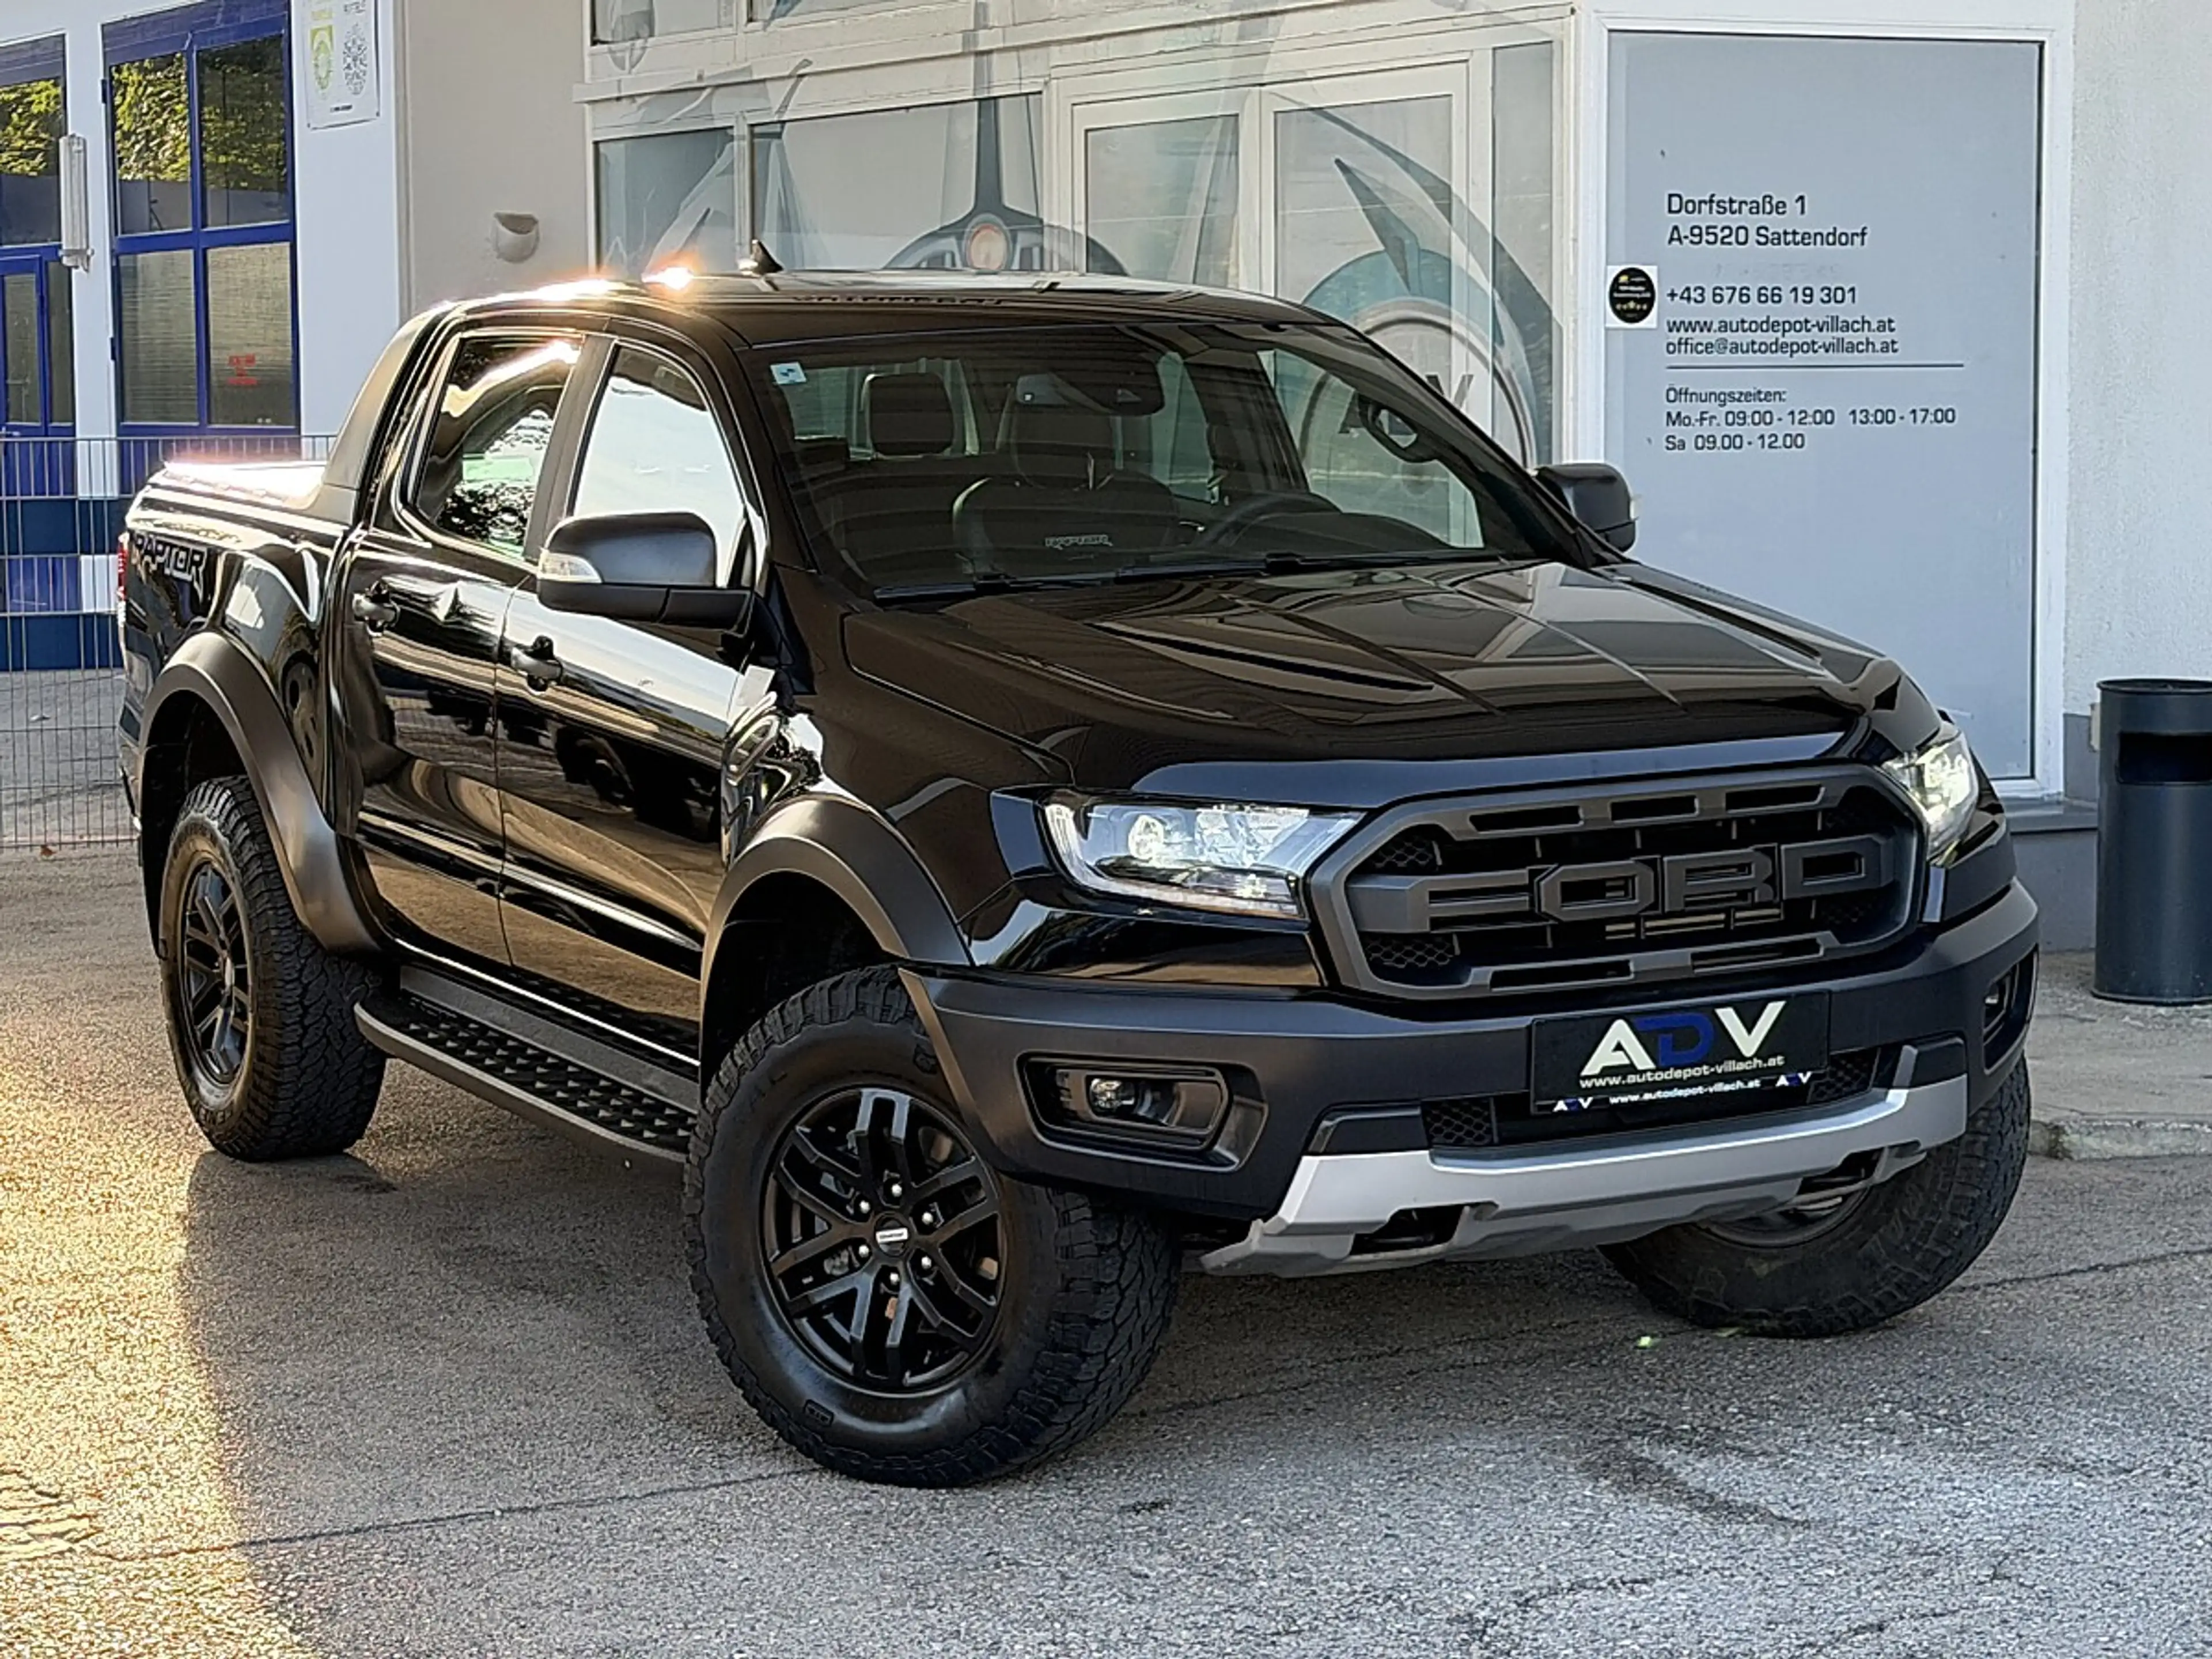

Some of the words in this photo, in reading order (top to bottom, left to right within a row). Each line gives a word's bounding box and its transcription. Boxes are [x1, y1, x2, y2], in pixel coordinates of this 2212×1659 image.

[1667, 193, 1787, 215] Dorfstraße
[1795, 195, 1806, 215] 1
[1668, 225, 1749, 246] A-9520
[1755, 225, 1868, 246] Sattendorf
[1667, 286, 1706, 304] +43
[1712, 286, 1751, 304] 676
[1757, 286, 1782, 304] 66
[1790, 286, 1814, 304] 19
[1820, 286, 1856, 304] 301
[1666, 315, 1896, 337] www.autodepot-villach.at
[1666, 337, 1899, 358] office@autodepot-villach.at
[1666, 384, 1787, 407] Öffnungszeiten:
[1666, 411, 1721, 427] Mo.-Fr.
[1725, 410, 1774, 426] 09:00
[1787, 409, 1835, 425] 12:00
[1849, 408, 1896, 425] 13:00
[1909, 408, 1956, 424] 17:00
[1665, 434, 1686, 450] Sa
[1694, 434, 1743, 450] 09.00
[1757, 433, 1805, 449] 12.00
[1374, 833, 1887, 934] FORD
[1580, 1001, 1786, 1077] ADV
[1579, 1055, 1785, 1089] www.autodepot-villach.at
[1609, 1078, 1762, 1104] www.autodepot-villach.at
